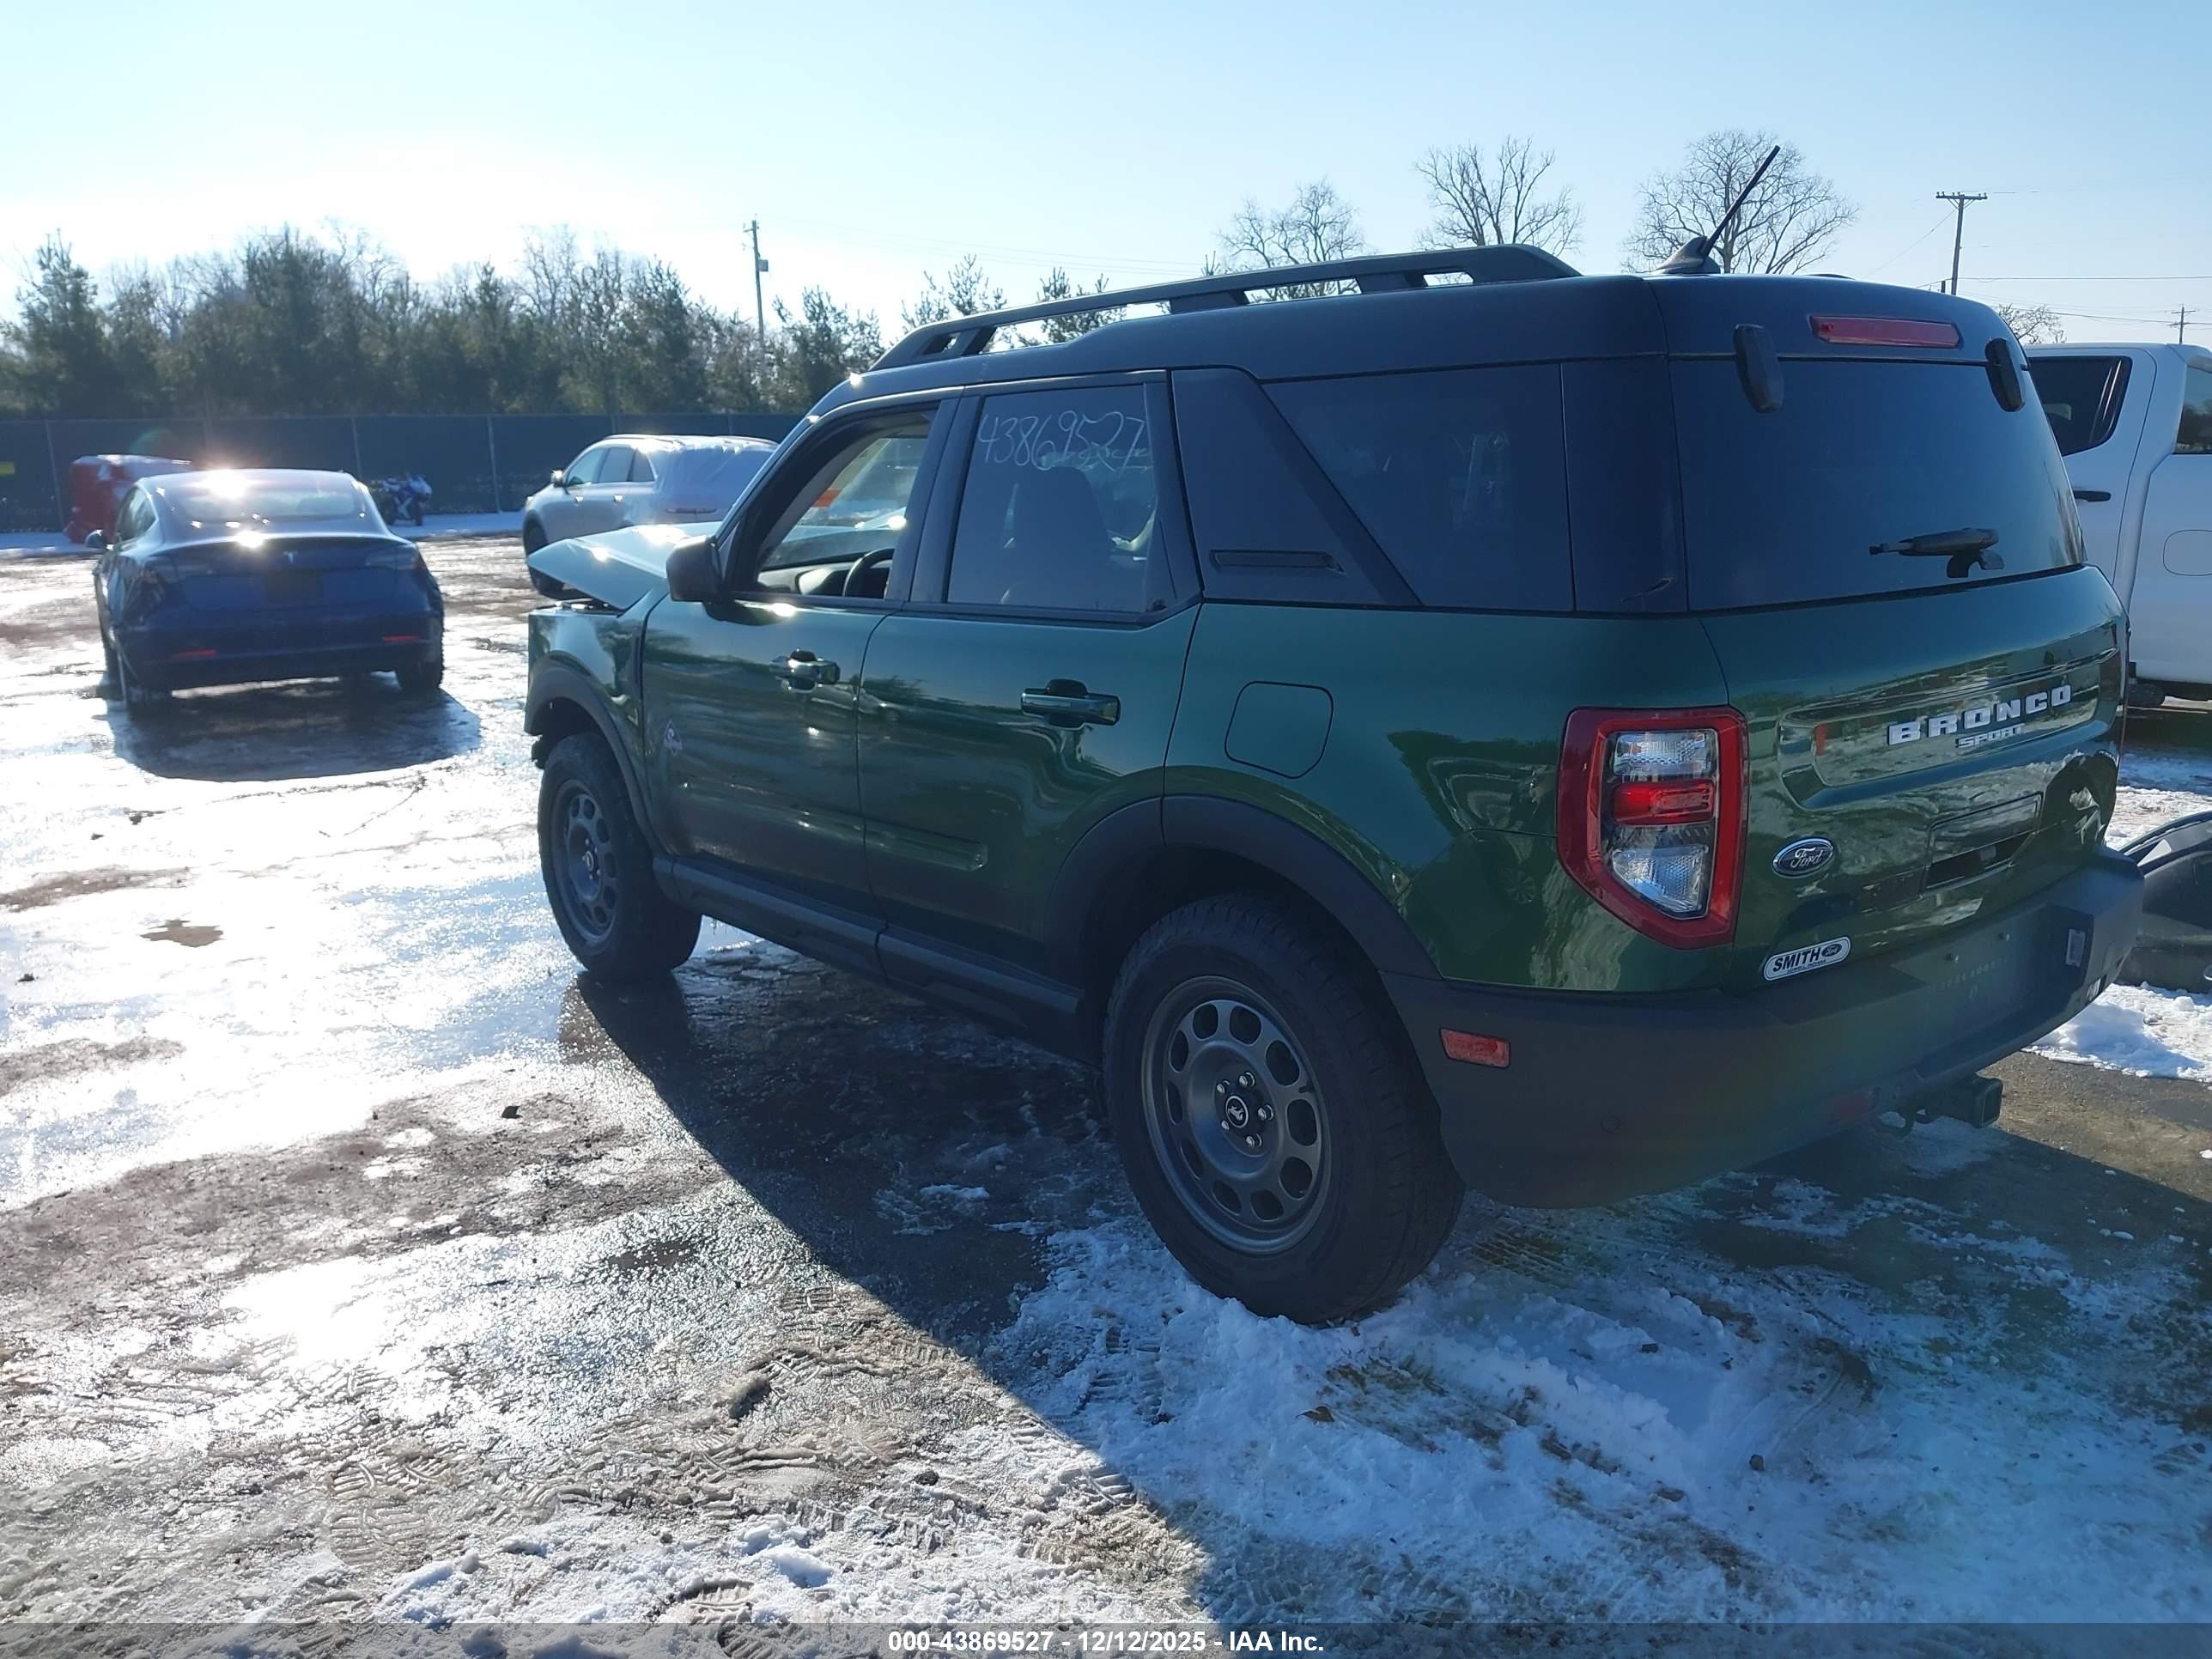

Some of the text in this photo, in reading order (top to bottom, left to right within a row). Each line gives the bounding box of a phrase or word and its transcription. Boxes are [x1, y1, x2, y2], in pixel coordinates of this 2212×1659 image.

[977, 410, 1146, 477] 43869527
[1887, 684, 2072, 746] BRONCO
[1958, 724, 2023, 748] SPORT
[1790, 847, 1823, 868] Ford
[1772, 947, 1821, 972] SMITH
